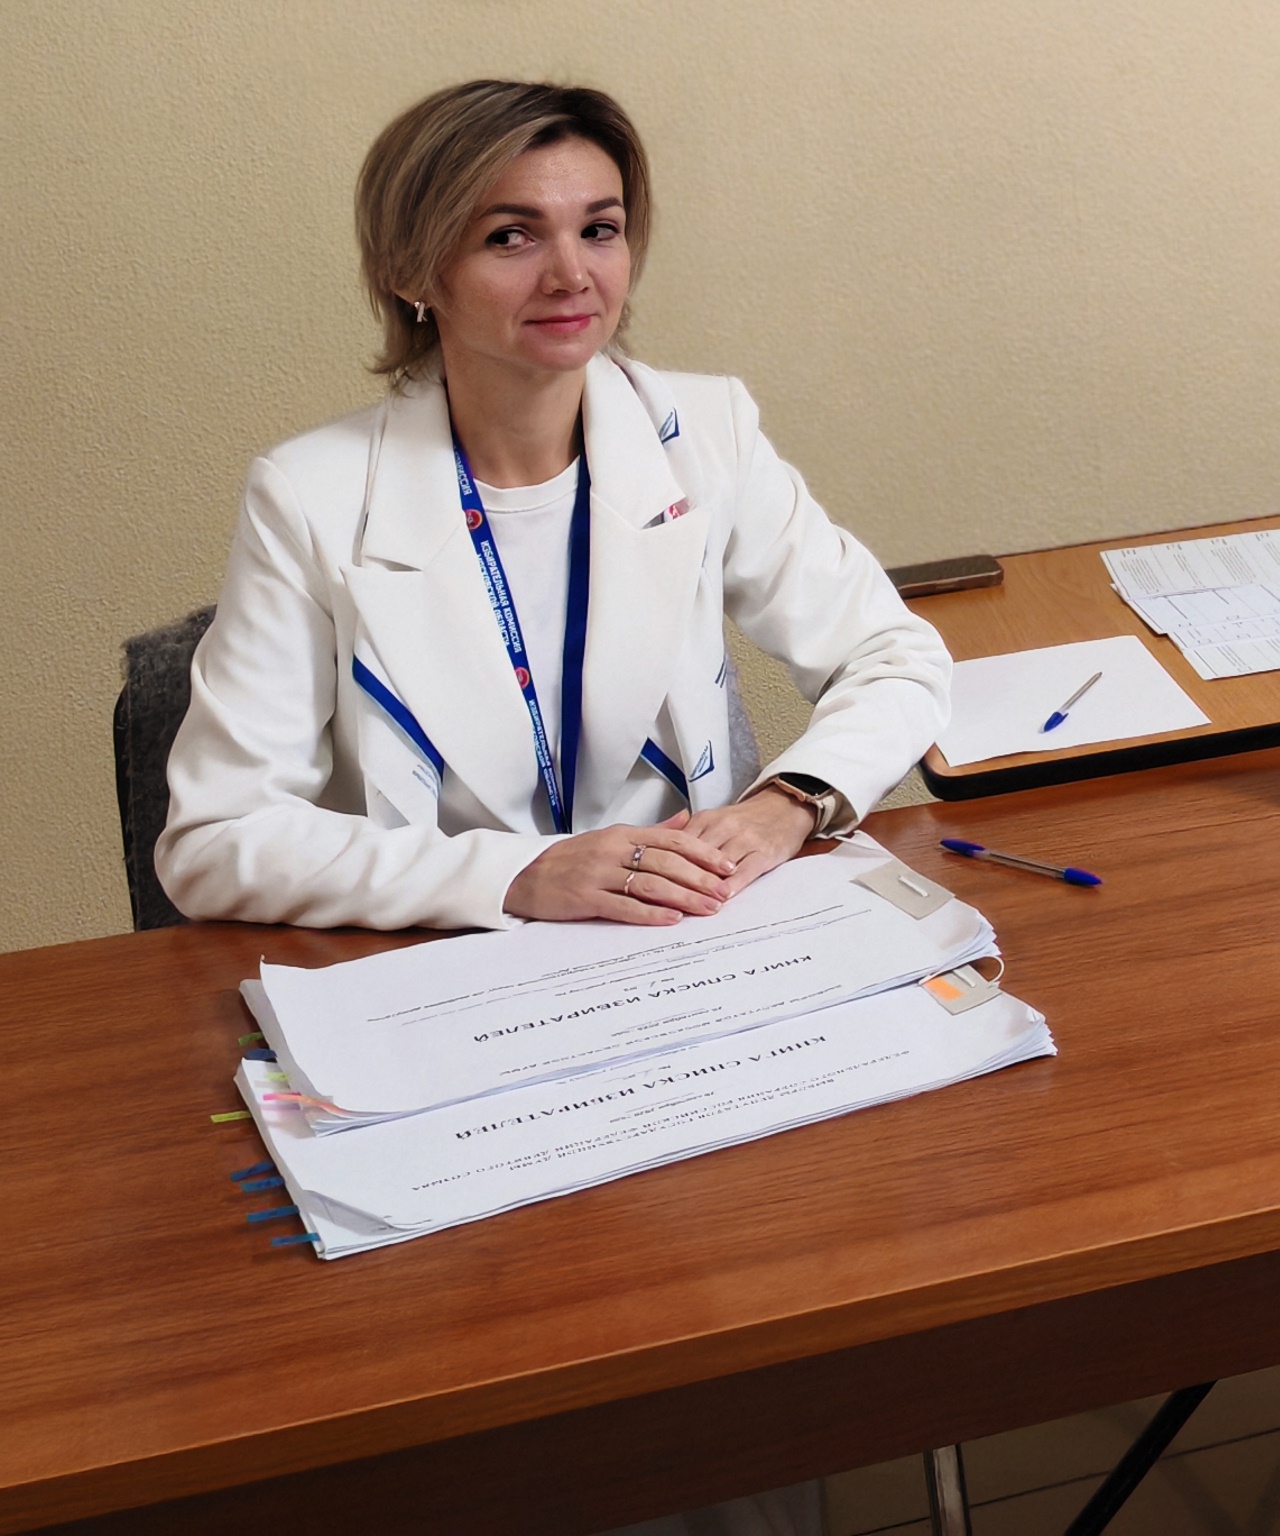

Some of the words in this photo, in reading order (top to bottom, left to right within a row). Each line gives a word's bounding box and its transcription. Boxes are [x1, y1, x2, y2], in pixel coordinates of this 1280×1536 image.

[743, 954, 813, 976] КНИГА
[648, 973, 737, 999] СПИСКА
[748, 1035, 827, 1062] КНИГА
[642, 1060, 741, 1090] СПИСКА
